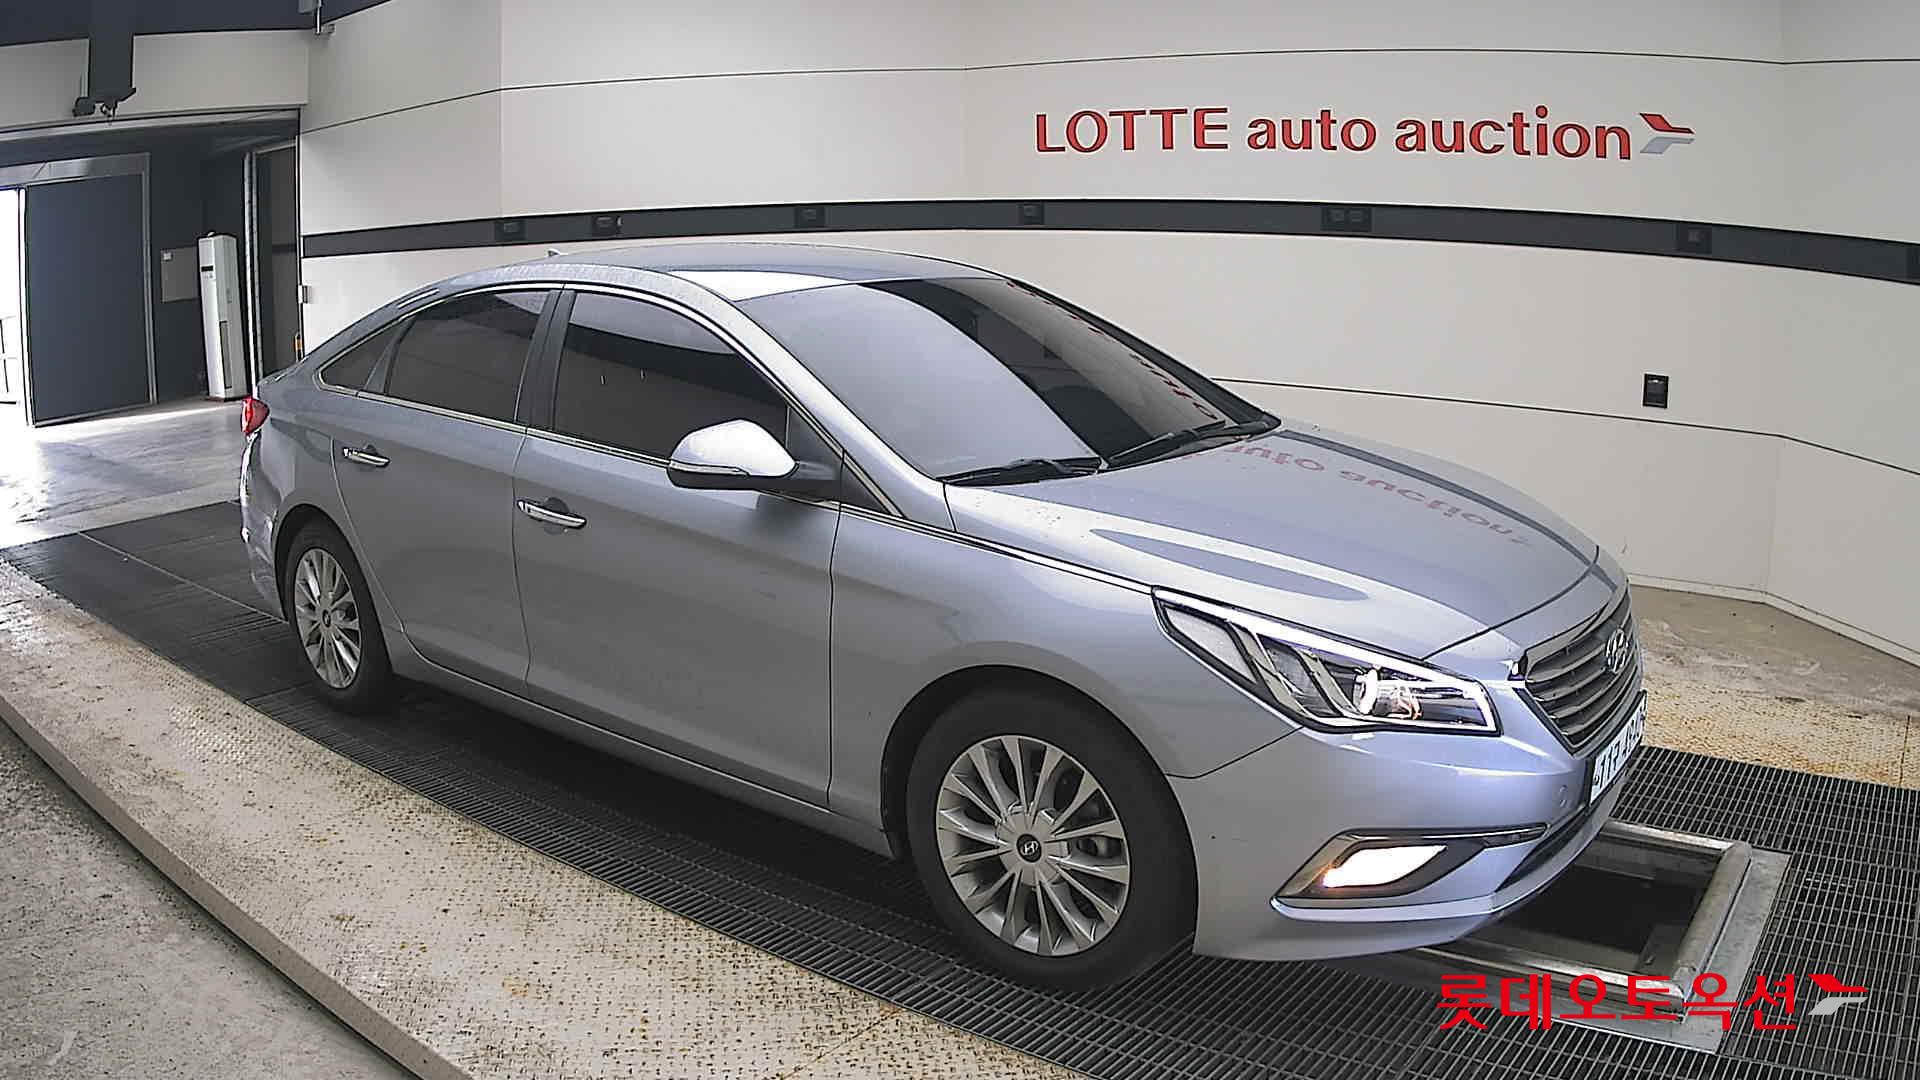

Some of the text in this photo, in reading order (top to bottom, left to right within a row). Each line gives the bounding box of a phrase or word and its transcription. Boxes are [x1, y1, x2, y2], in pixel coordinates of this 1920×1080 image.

[1036, 105, 1632, 160] LOTTE auto auction
